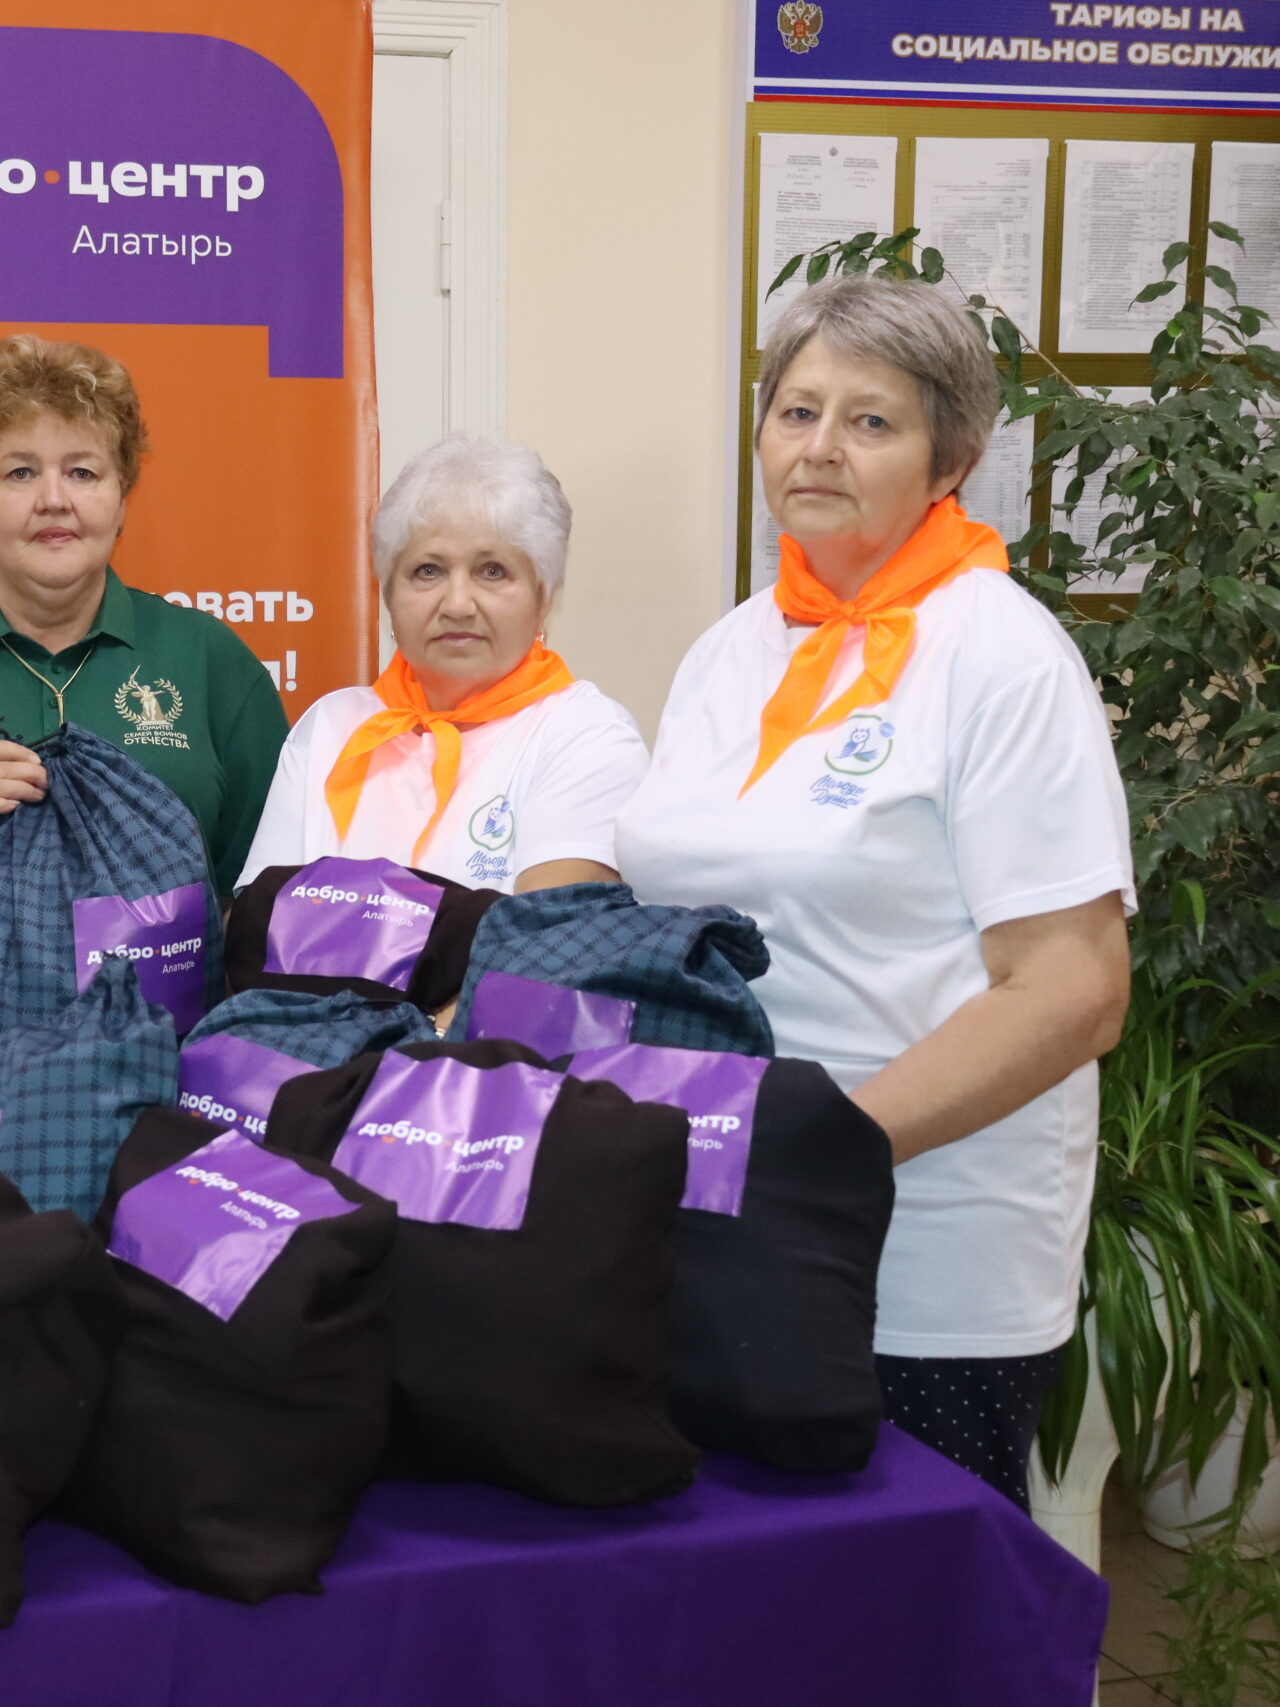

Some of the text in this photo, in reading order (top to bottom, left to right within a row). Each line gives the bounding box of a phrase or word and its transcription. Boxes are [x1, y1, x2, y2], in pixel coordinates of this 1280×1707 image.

[1049, 2, 1246, 32] ТАРИФЫ НА
[891, 33, 1120, 64] СОЦИАЛЬНОЕ
[67, 159, 265, 213] центр
[71, 224, 233, 265] Алатырь
[123, 736, 191, 750] ОТЕЧЕСТВА
[124, 730, 188, 740] СЕМЕЙ ВОИНОВ
[291, 885, 431, 915] добро центр
[361, 910, 414, 928] Алатырь
[161, 937, 202, 958] центр
[161, 960, 195, 975] Алатырь
[179, 1090, 238, 1122] добро
[358, 1120, 525, 1157] добро центр
[687, 1114, 741, 1135] нтр
[175, 1165, 301, 1220] добро центр
[220, 1200, 268, 1230] Алатырь
